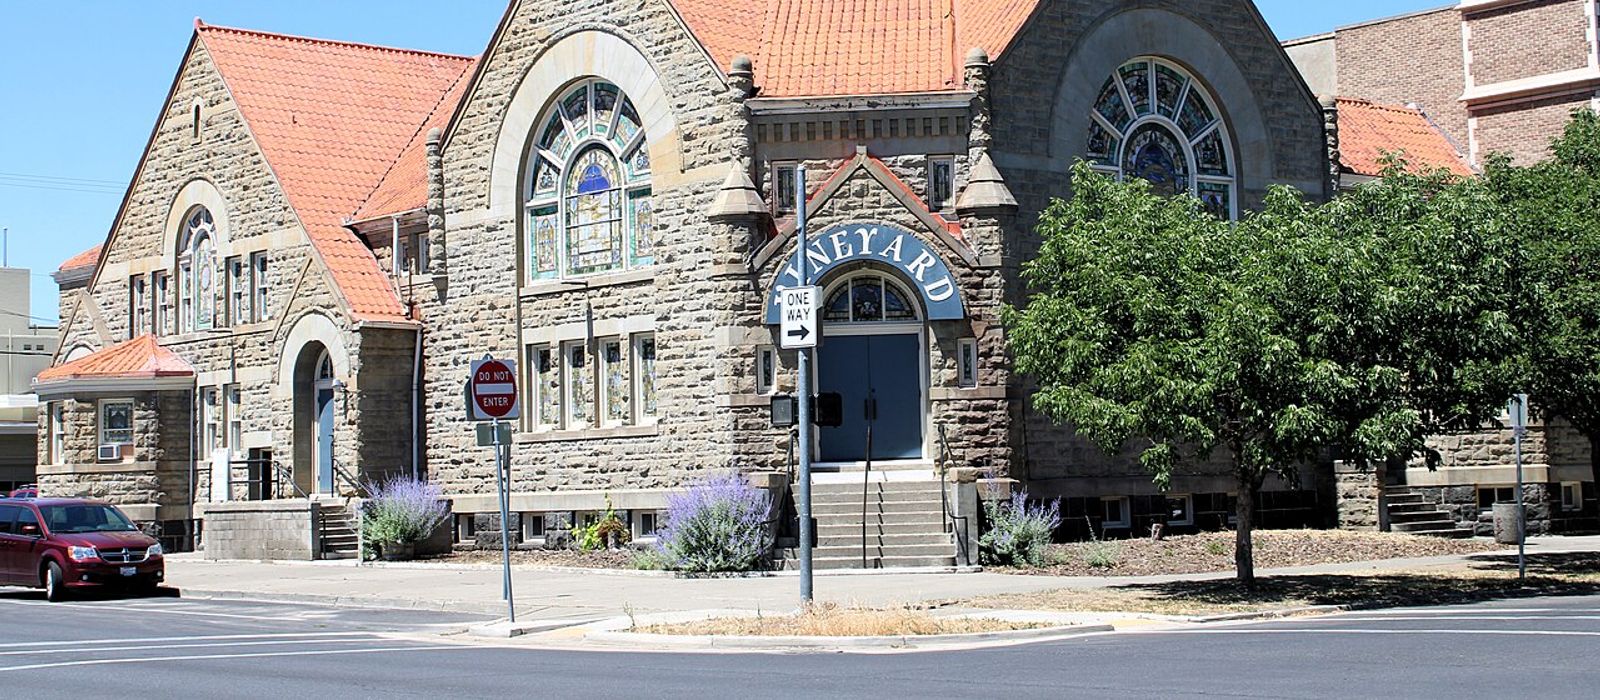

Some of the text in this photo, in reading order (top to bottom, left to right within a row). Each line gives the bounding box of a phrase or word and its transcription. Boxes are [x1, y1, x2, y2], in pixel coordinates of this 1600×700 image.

[788, 292, 810, 306] ONE
[787, 308, 810, 321] WAY
[479, 371, 509, 381] DO NOT
[483, 397, 509, 407] ENTER
